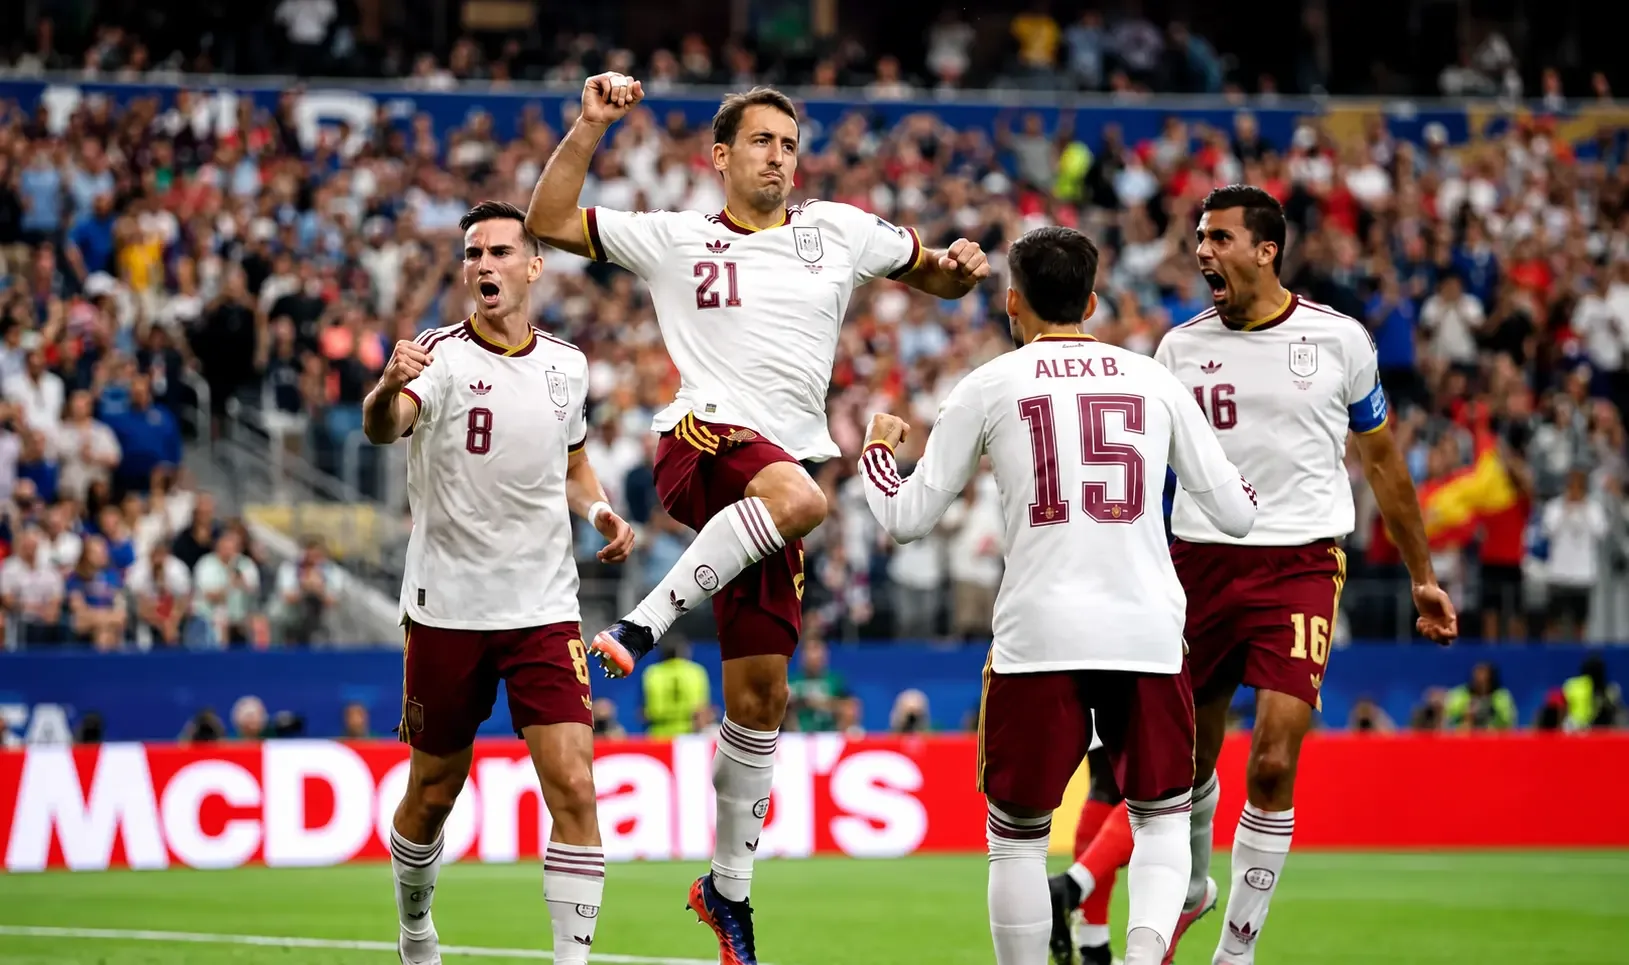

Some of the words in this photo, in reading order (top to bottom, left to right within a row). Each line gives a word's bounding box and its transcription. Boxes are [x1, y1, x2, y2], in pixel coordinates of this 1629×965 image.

[693, 261, 742, 310] 21
[1035, 358, 1096, 379] ALEX
[1101, 356, 1125, 377] B.
[466, 407, 493, 455] 8
[1193, 383, 1238, 431] 16
[1017, 393, 1146, 527] 15
[567, 638, 589, 686] 8
[1290, 613, 1330, 666] 16
